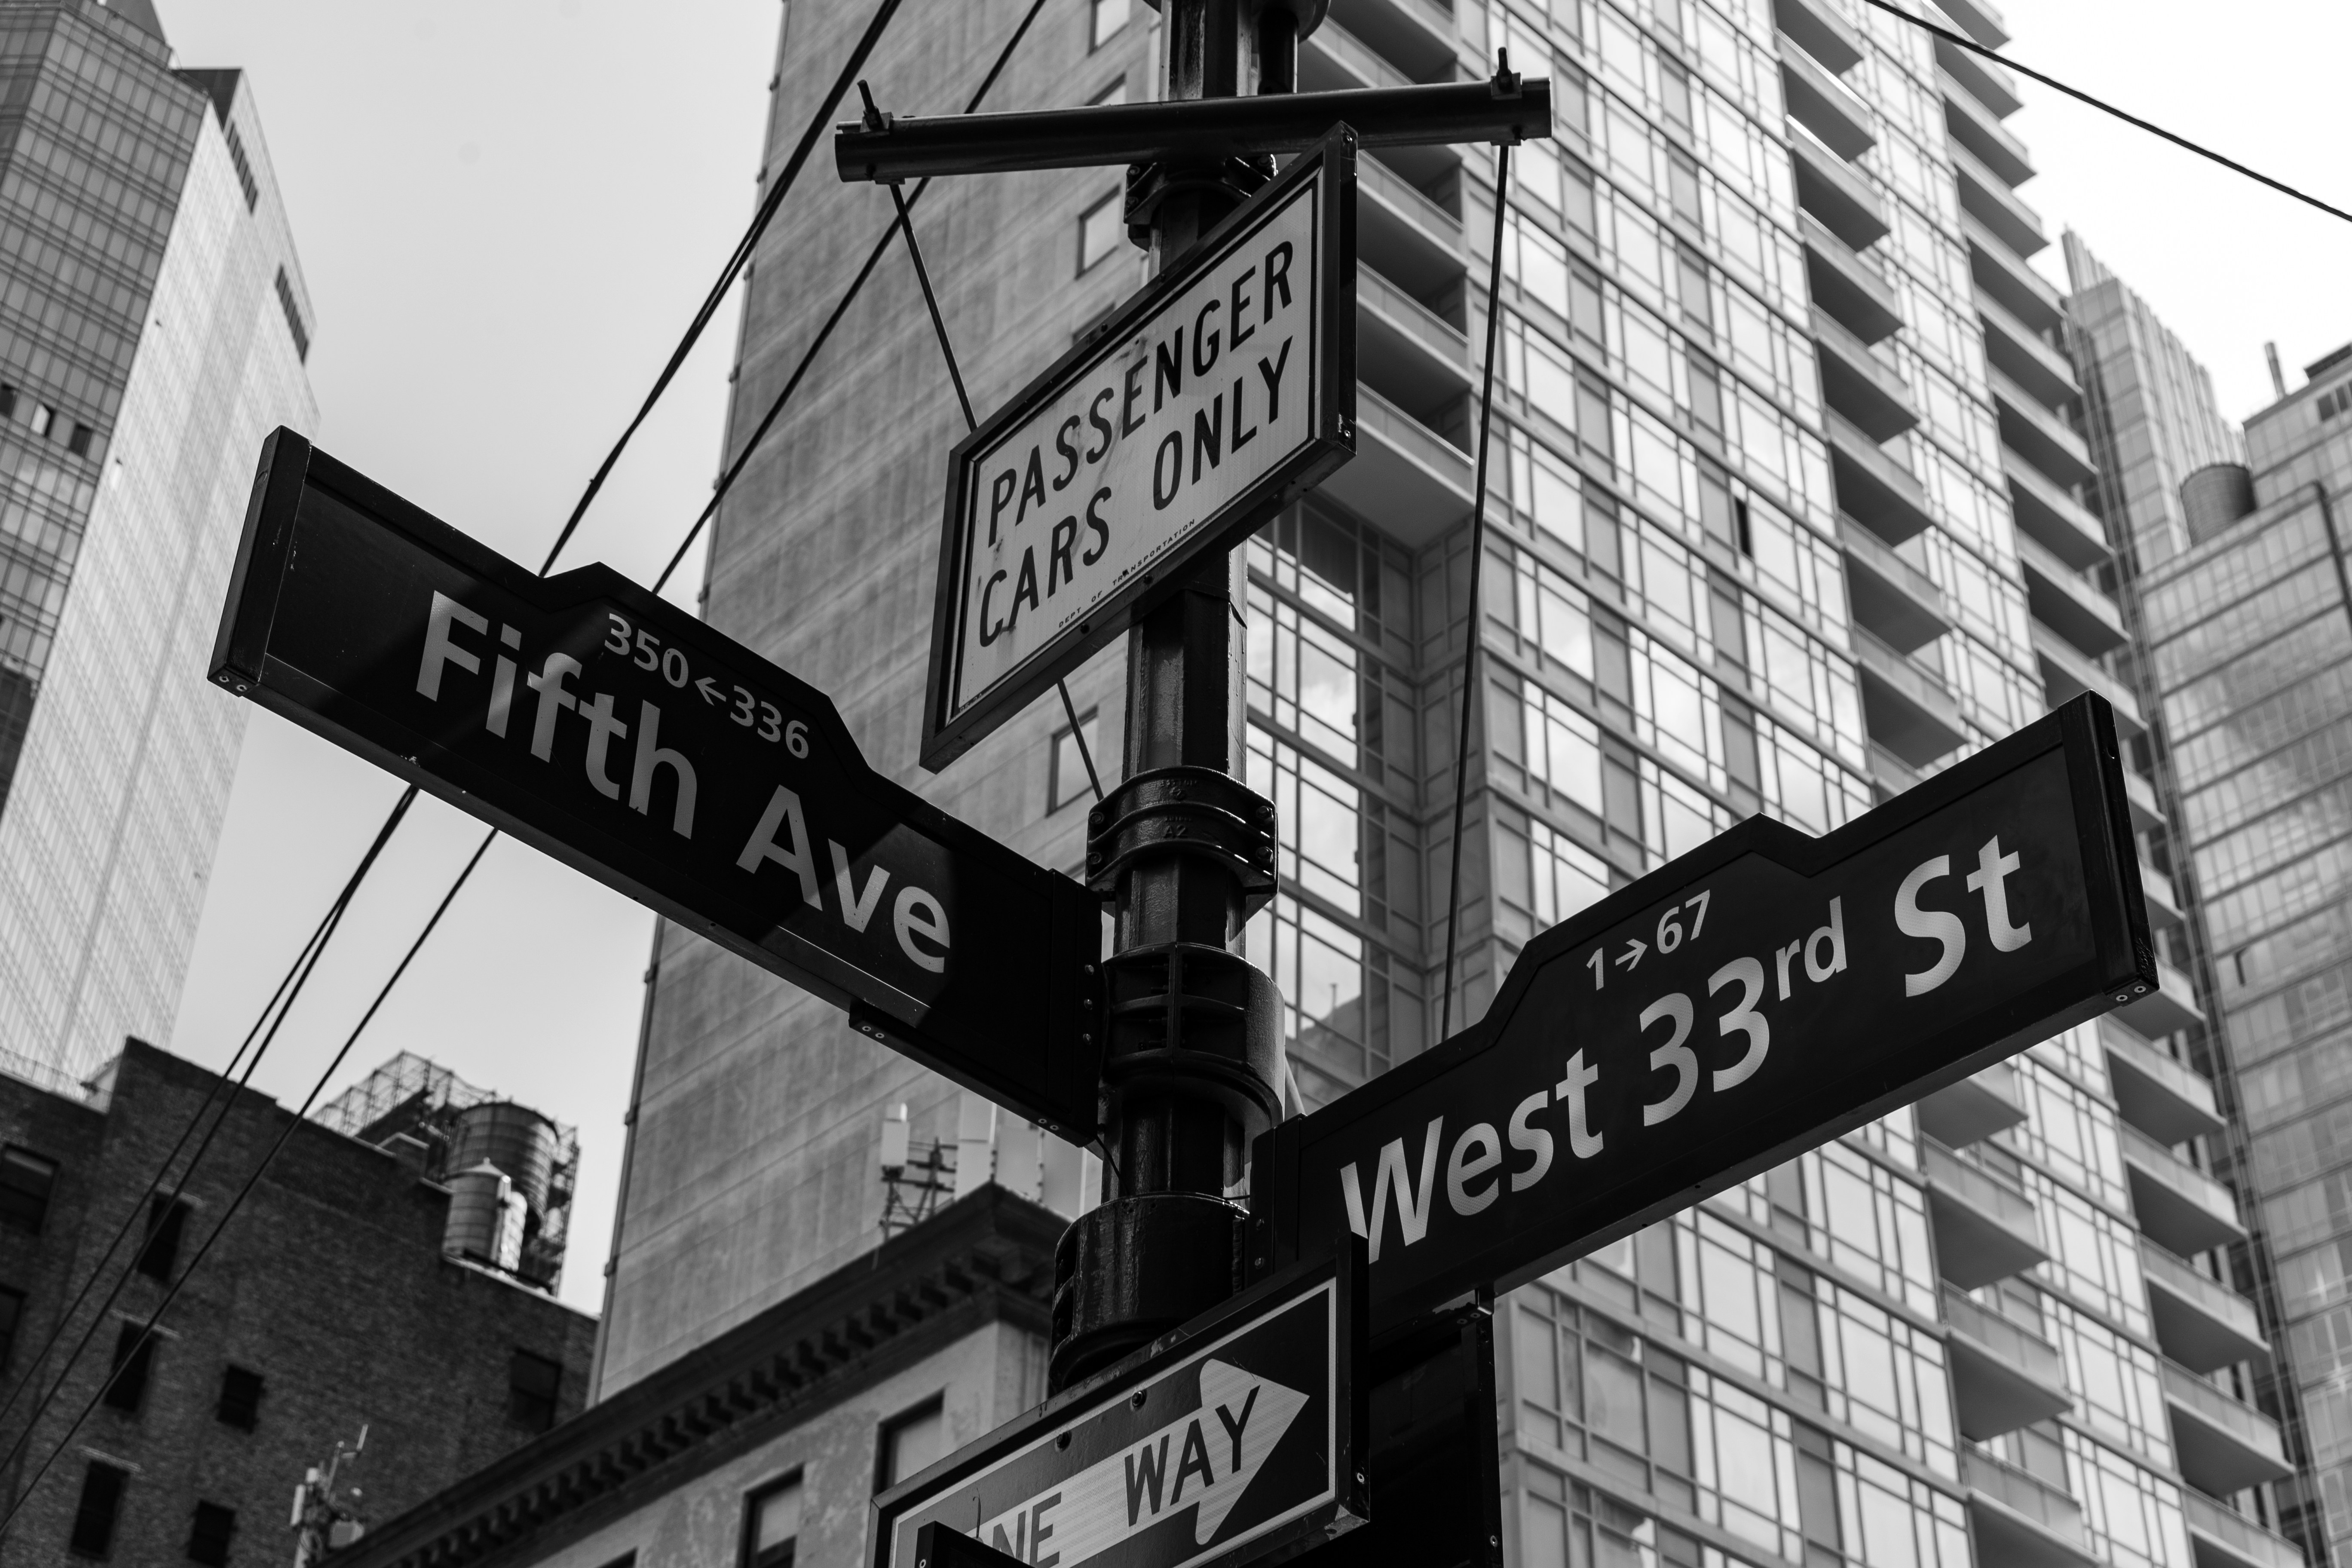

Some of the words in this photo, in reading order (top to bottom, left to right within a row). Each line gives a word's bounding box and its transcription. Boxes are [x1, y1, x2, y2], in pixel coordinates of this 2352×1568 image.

[980, 487, 1112, 648] CARS
[1153, 335, 1293, 510] ONLY
[989, 241, 1293, 548] PASSENGER
[604, 613, 689, 688] 350
[730, 685, 809, 759] 336
[1058, 607, 1081, 628] DEPT
[1091, 590, 1102, 603] OF
[1112, 518, 1195, 586] TRANSPORTATION
[416, 589, 698, 839] Fifth
[735, 784, 950, 973] Ave
[1340, 1047, 1604, 1265] West
[1639, 895, 1847, 1127] 33rd
[1894, 834, 2032, 998] St
[1586, 947, 1604, 991] 1
[1656, 889, 1711, 954] 67
[973, 1491, 1062, 1568] NE
[1124, 1384, 1261, 1527] WAY
